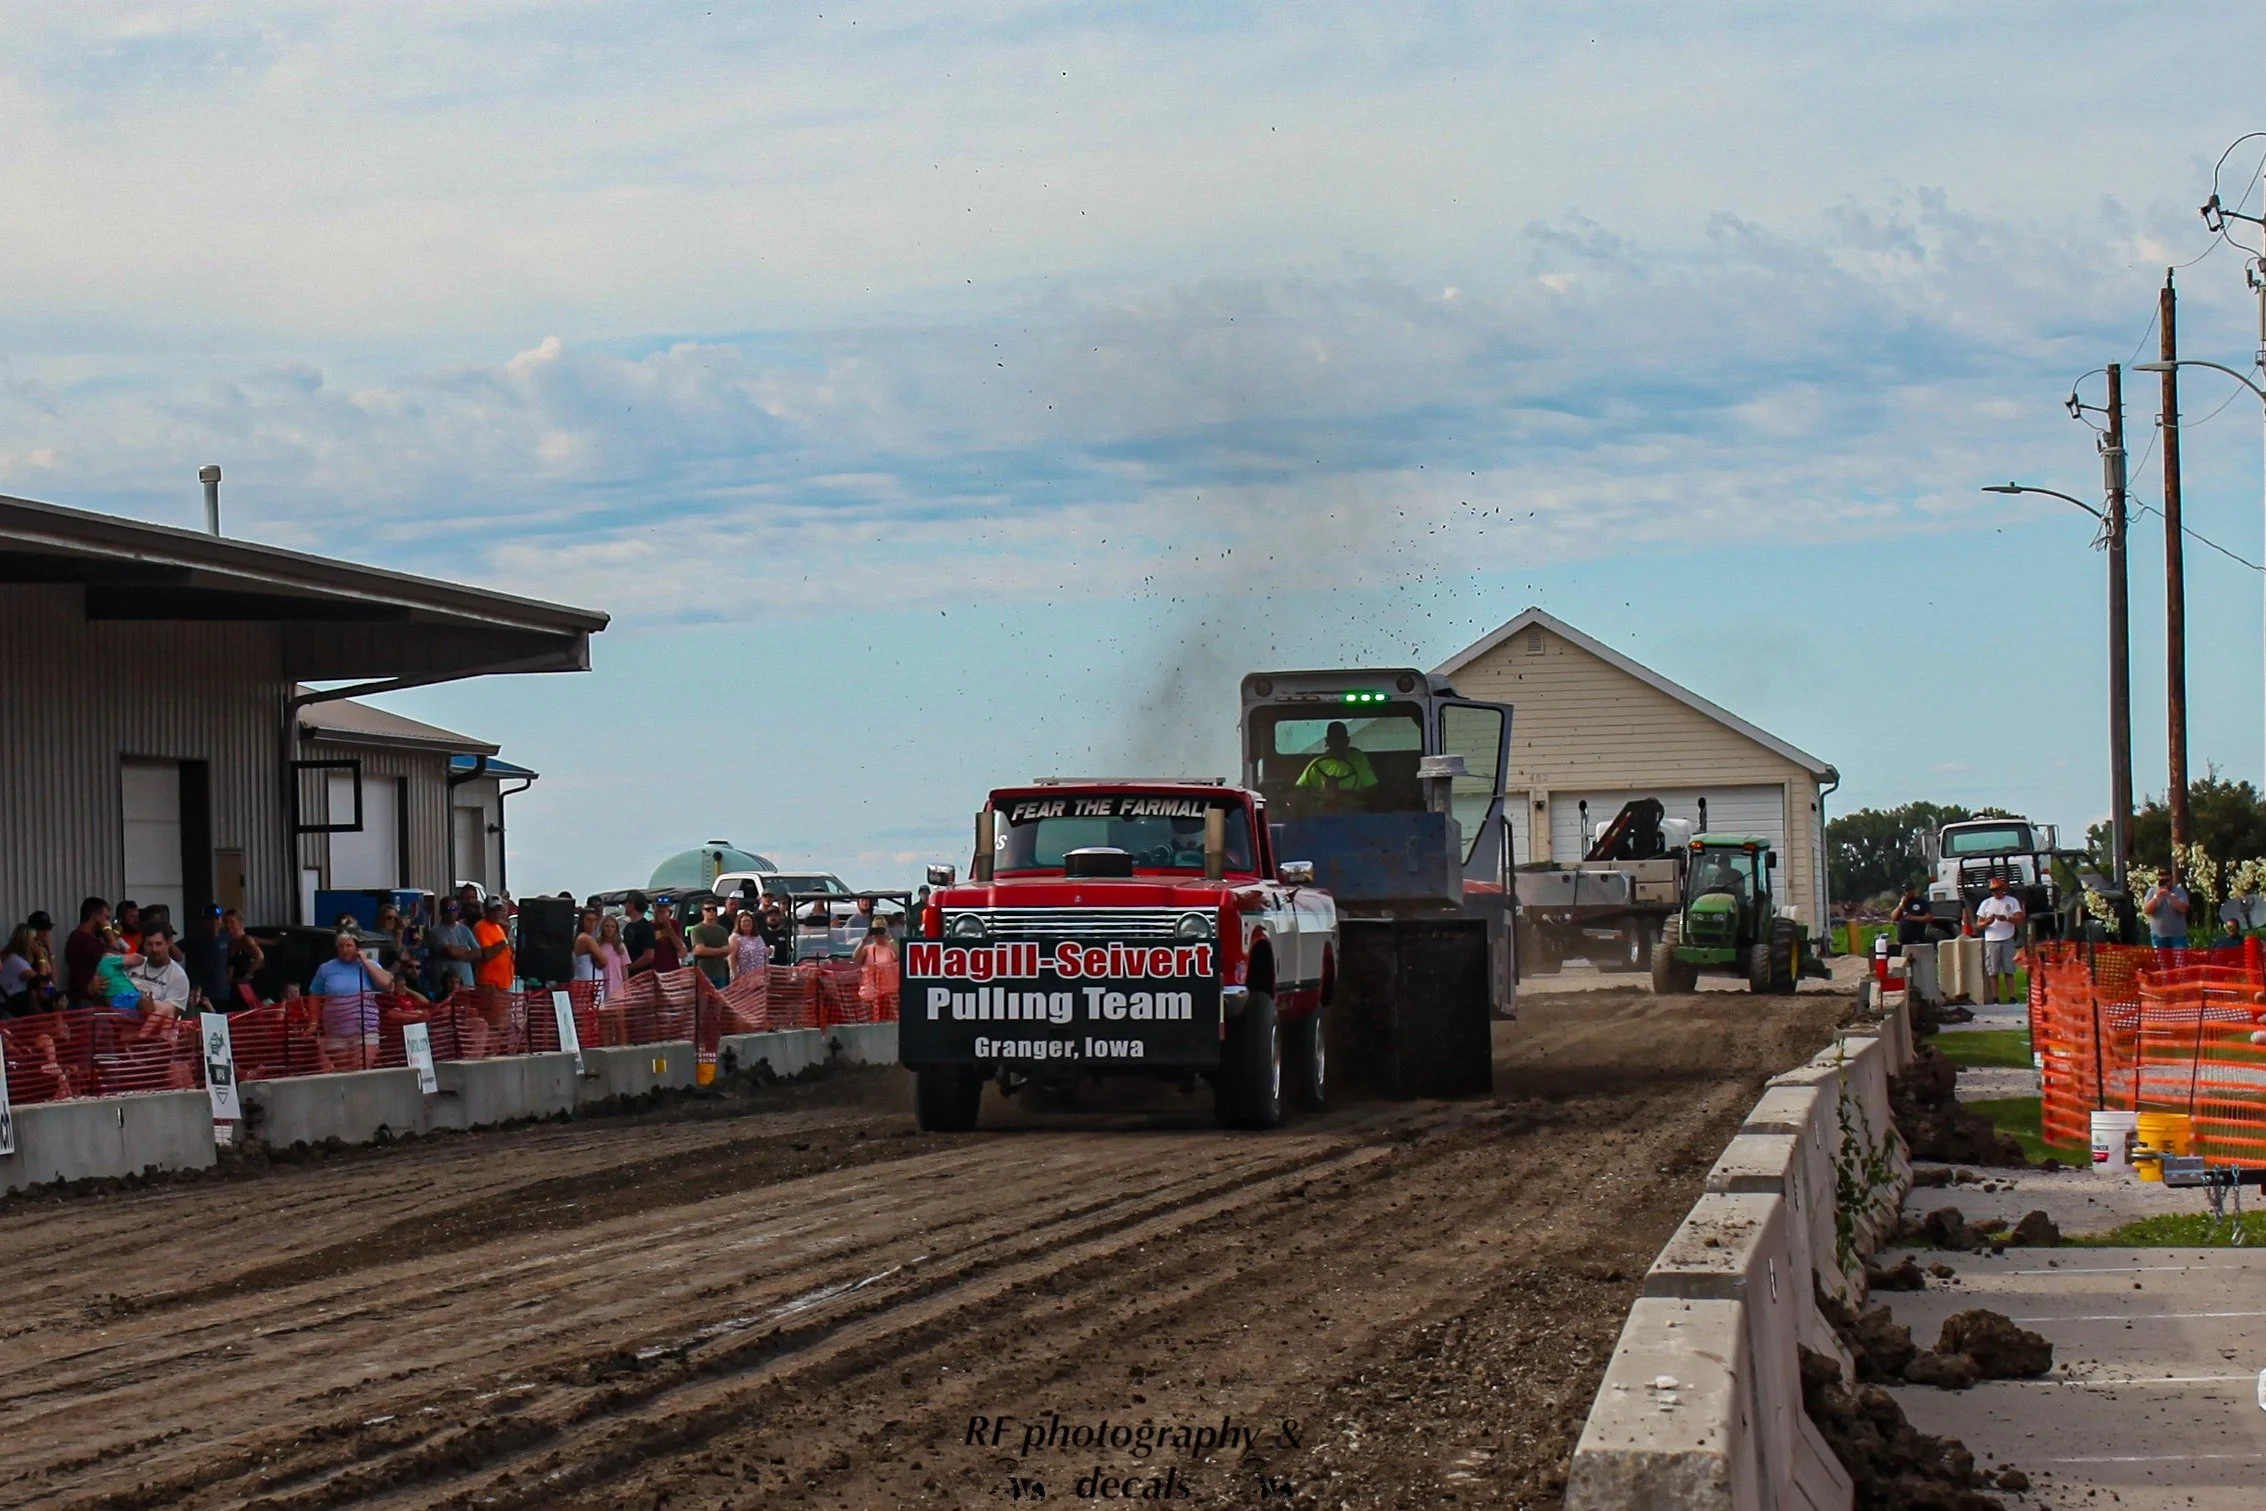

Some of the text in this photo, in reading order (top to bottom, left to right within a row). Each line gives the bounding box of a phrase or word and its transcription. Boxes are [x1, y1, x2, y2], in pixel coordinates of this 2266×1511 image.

[1011, 800, 1066, 821] FEAR
[1075, 799, 1114, 816] THE
[906, 941, 1214, 982] Magill-Seivert
[927, 987, 1192, 1024] Pulling Team
[975, 1036, 1145, 1060] Granger, Iowa
